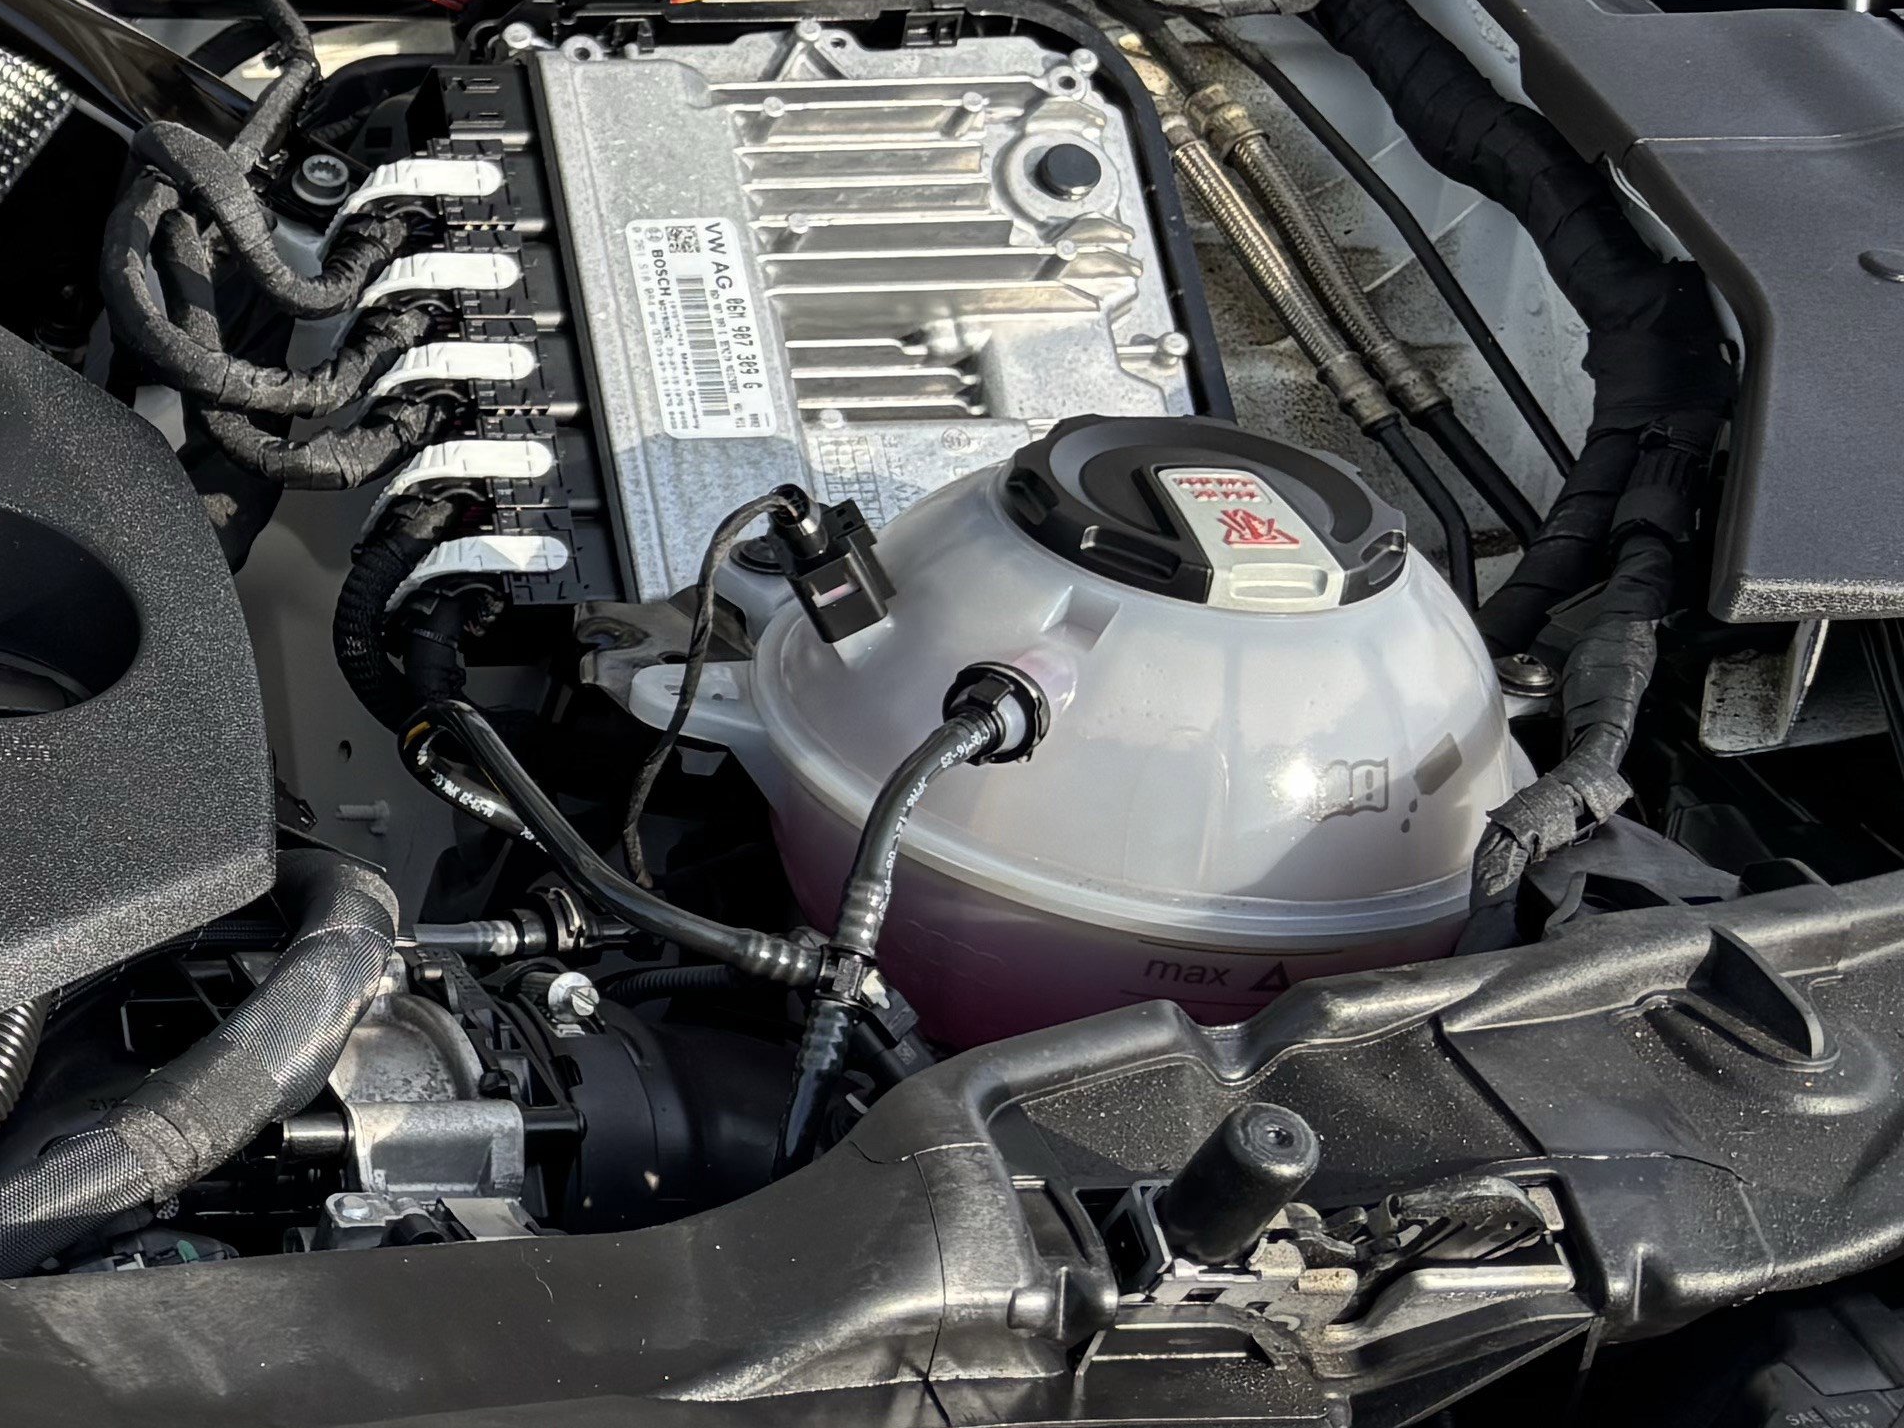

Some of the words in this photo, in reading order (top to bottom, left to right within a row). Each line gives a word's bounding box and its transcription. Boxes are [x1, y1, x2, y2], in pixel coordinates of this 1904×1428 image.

[705, 222, 727, 255] VW
[652, 249, 672, 296] BOSCH
[711, 261, 733, 290] AG
[732, 326, 754, 347] 907
[1145, 960, 1230, 986] max
